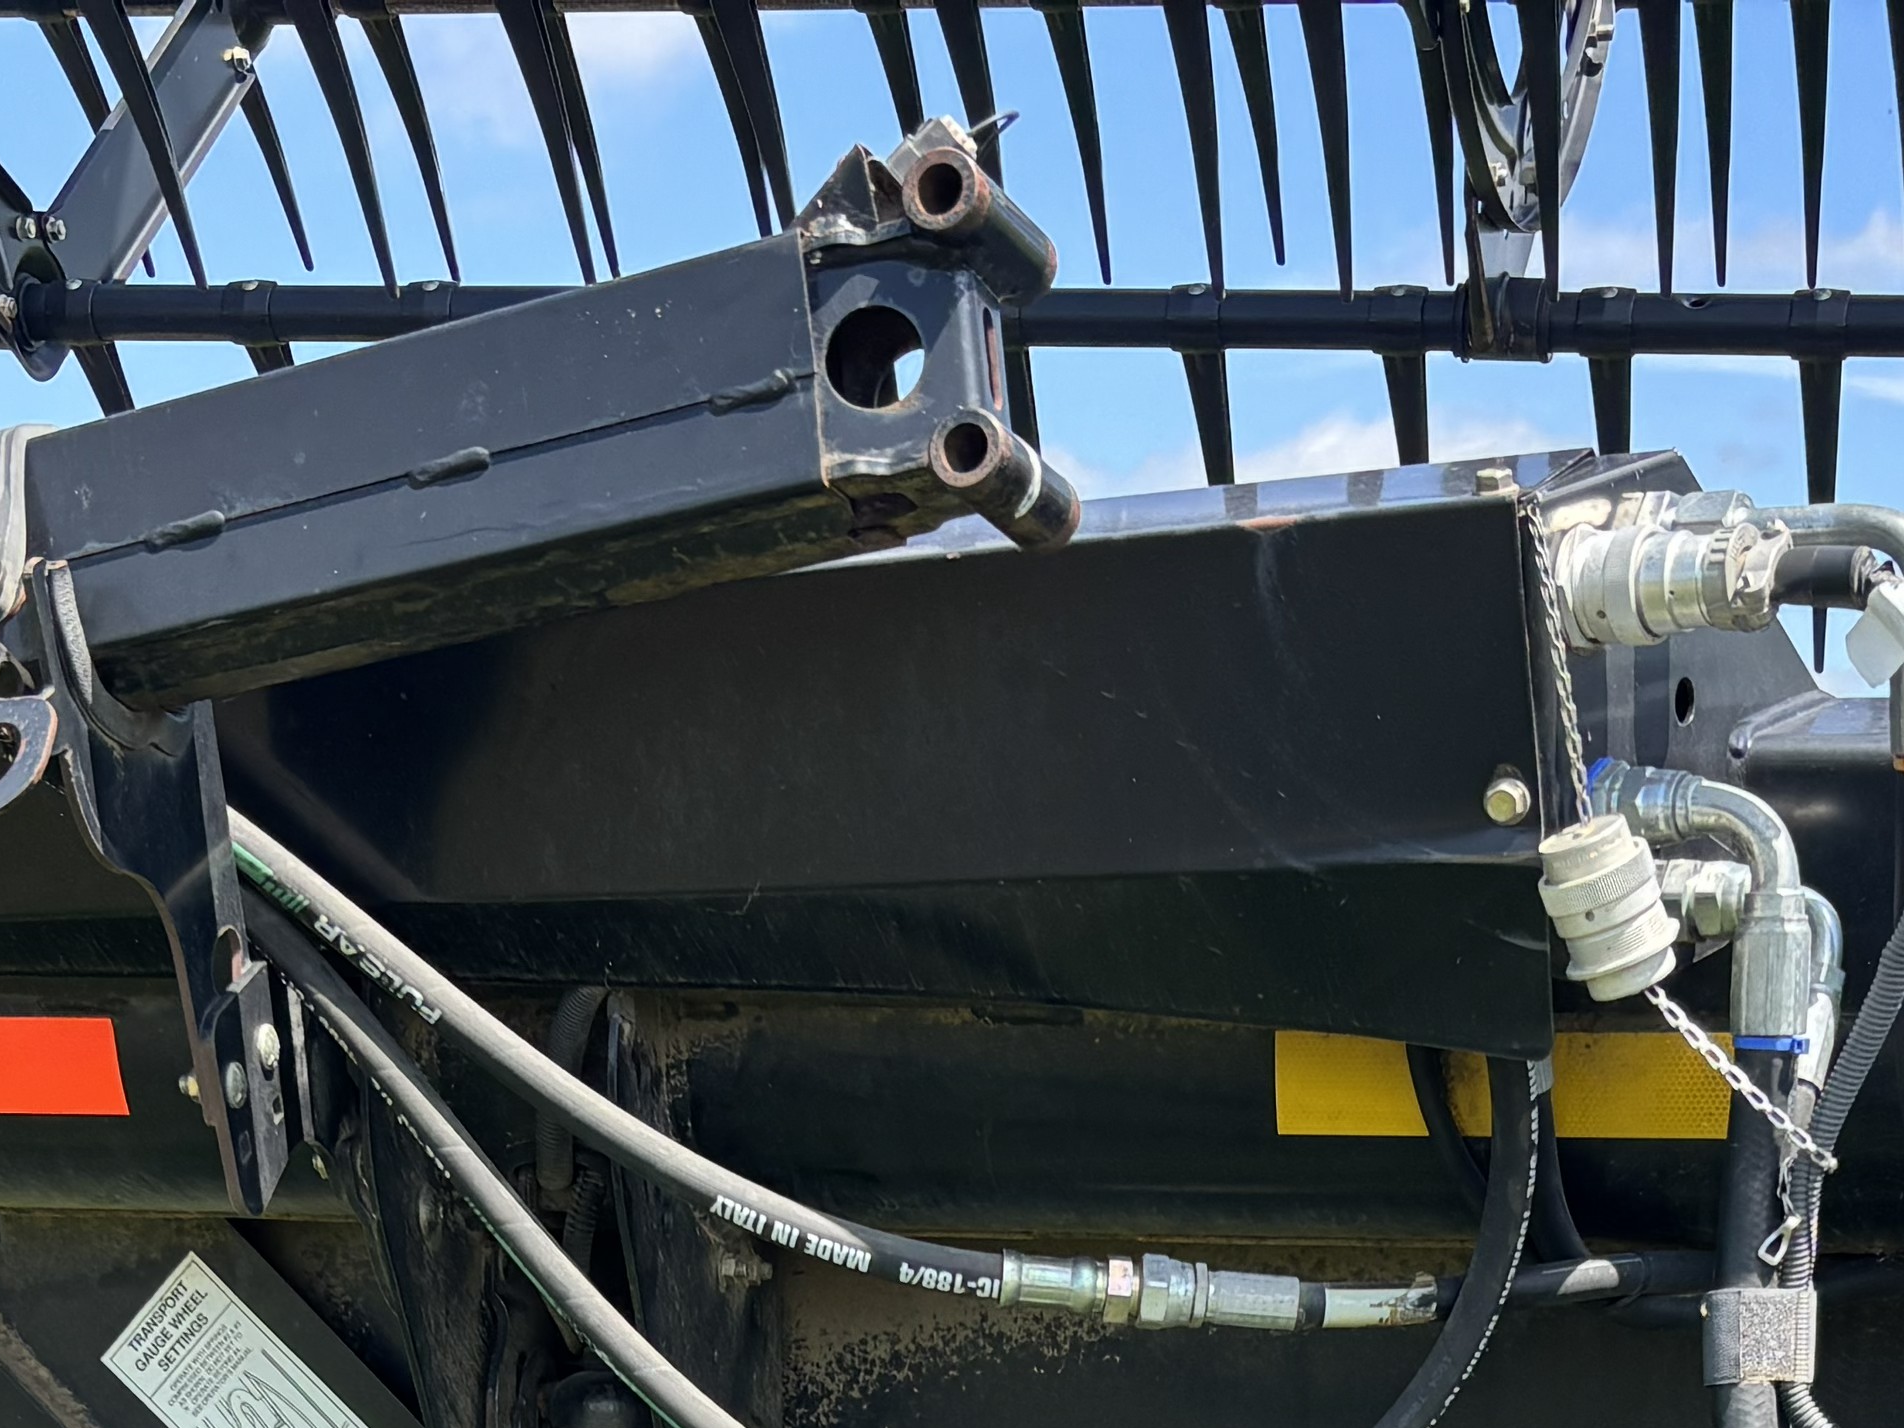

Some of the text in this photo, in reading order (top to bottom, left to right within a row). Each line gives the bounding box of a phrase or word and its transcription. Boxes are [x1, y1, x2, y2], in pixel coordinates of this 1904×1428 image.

[314, 914, 443, 1025] PULSAR
[709, 1194, 1001, 1298] IC-188/4 MADE IN ITALY
[125, 1279, 192, 1353] TRANSPORT
[131, 1285, 210, 1373] GAUGE WHEEL
[154, 1311, 212, 1373] SETTINGS
[234, 1332, 244, 1342] TO
[167, 1367, 202, 1407] COMPRESSED
[199, 1340, 225, 1369] BETWEEN
[169, 1324, 228, 1391] OPERATE WITH SPRINGS
[190, 1378, 214, 1405] OPERATE
[212, 1354, 234, 1379] BEYOND
